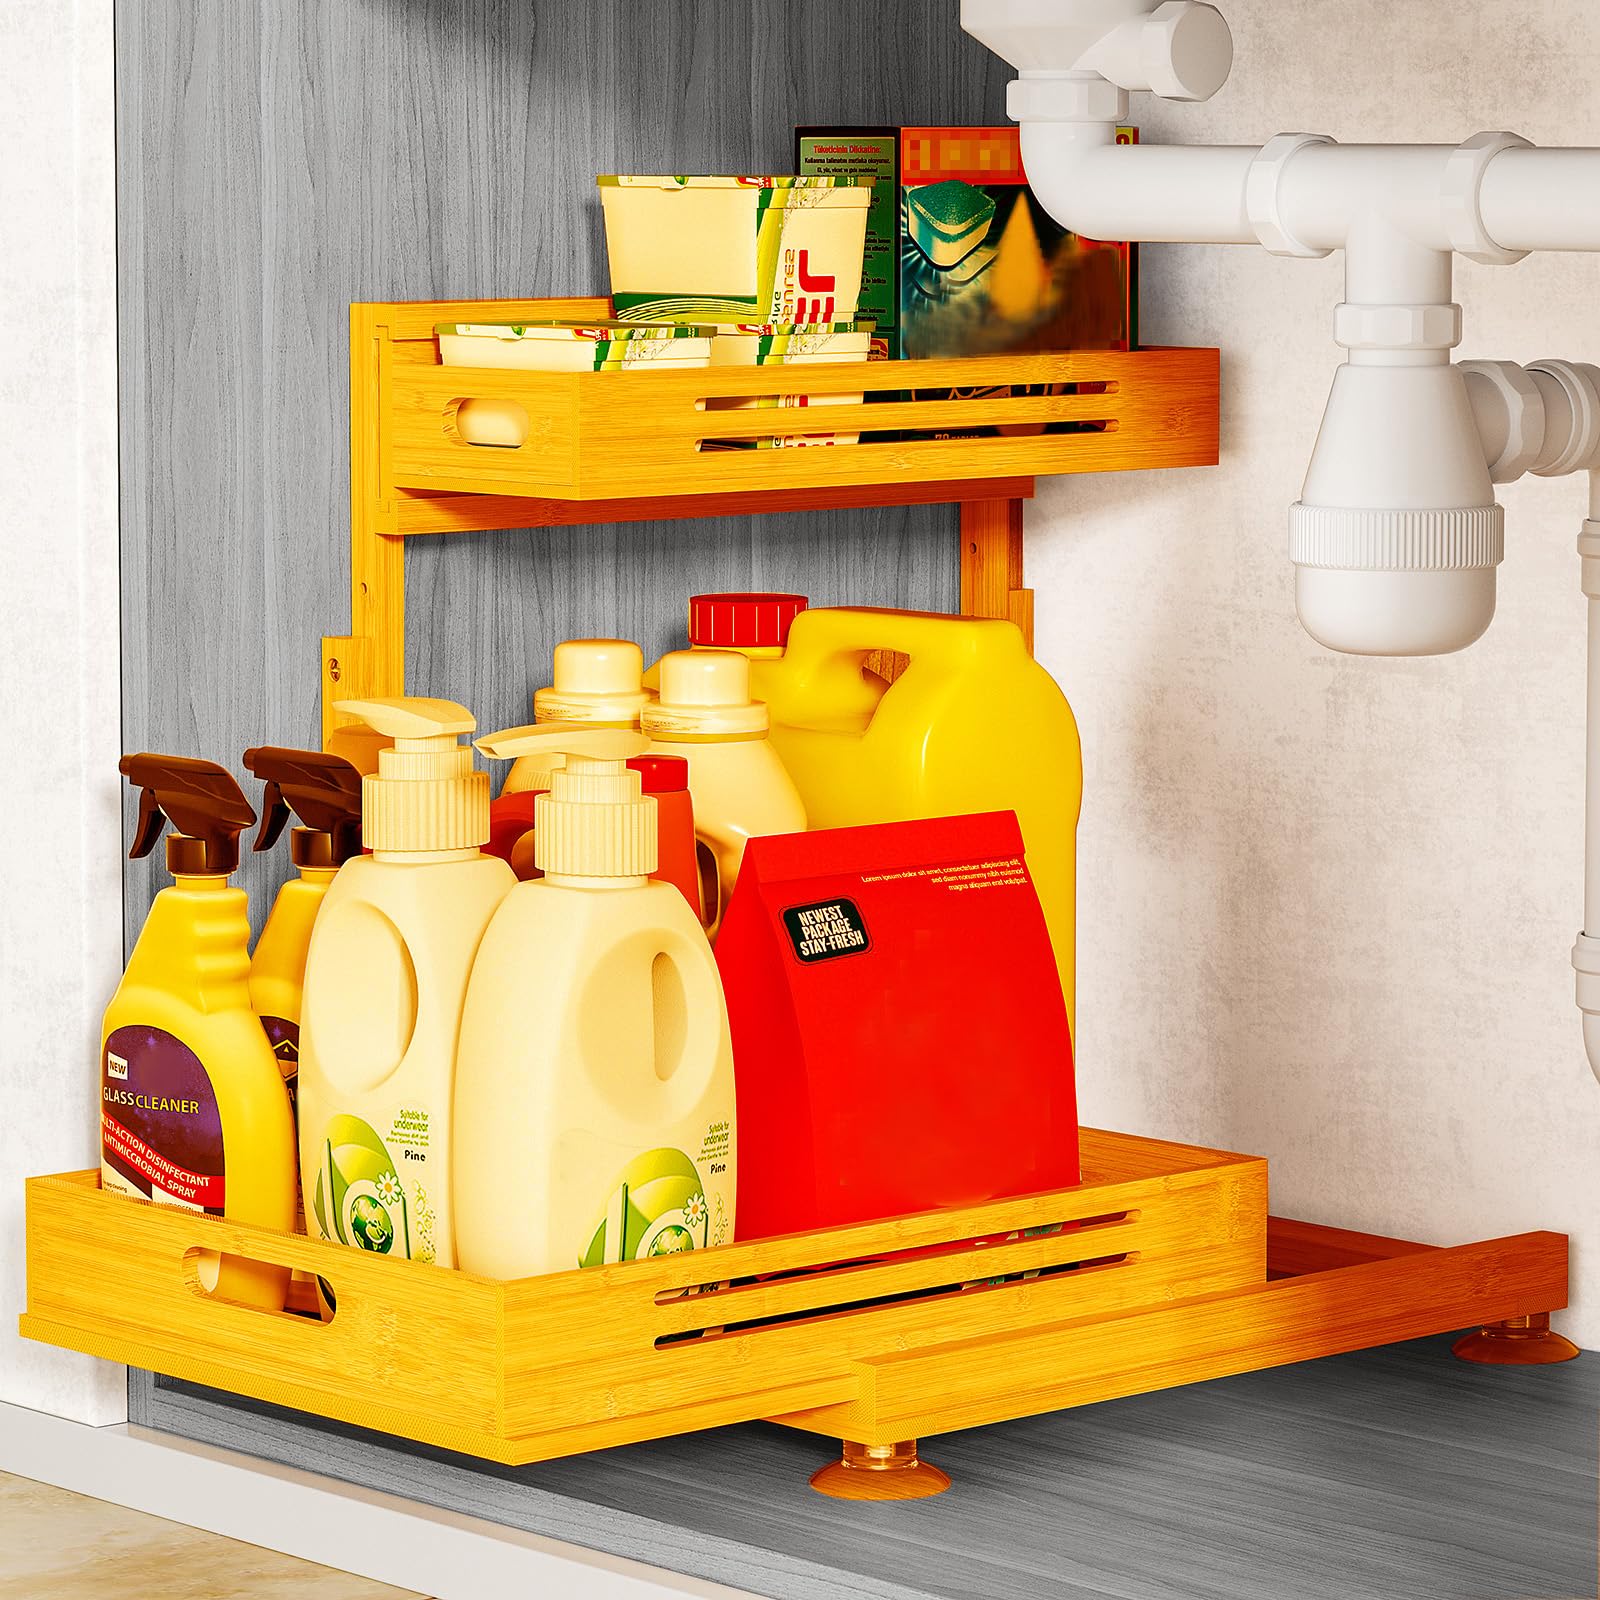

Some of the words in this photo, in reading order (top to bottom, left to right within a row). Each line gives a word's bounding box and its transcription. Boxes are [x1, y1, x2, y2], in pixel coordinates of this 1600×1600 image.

[797, 905, 844, 927] NEWEST
[801, 917, 853, 940] PACKAGE
[799, 929, 865, 956] STAY-FRESH
[109, 1061, 126, 1075] NEW
[103, 1086, 135, 1106] GLASS
[135, 1094, 199, 1114] CLEANER
[404, 1149, 426, 1162] Pine
[145, 1149, 211, 1187] DISINFECTANT
[710, 1162, 726, 1174] Pine
[166, 1180, 197, 1199] SPRAY
